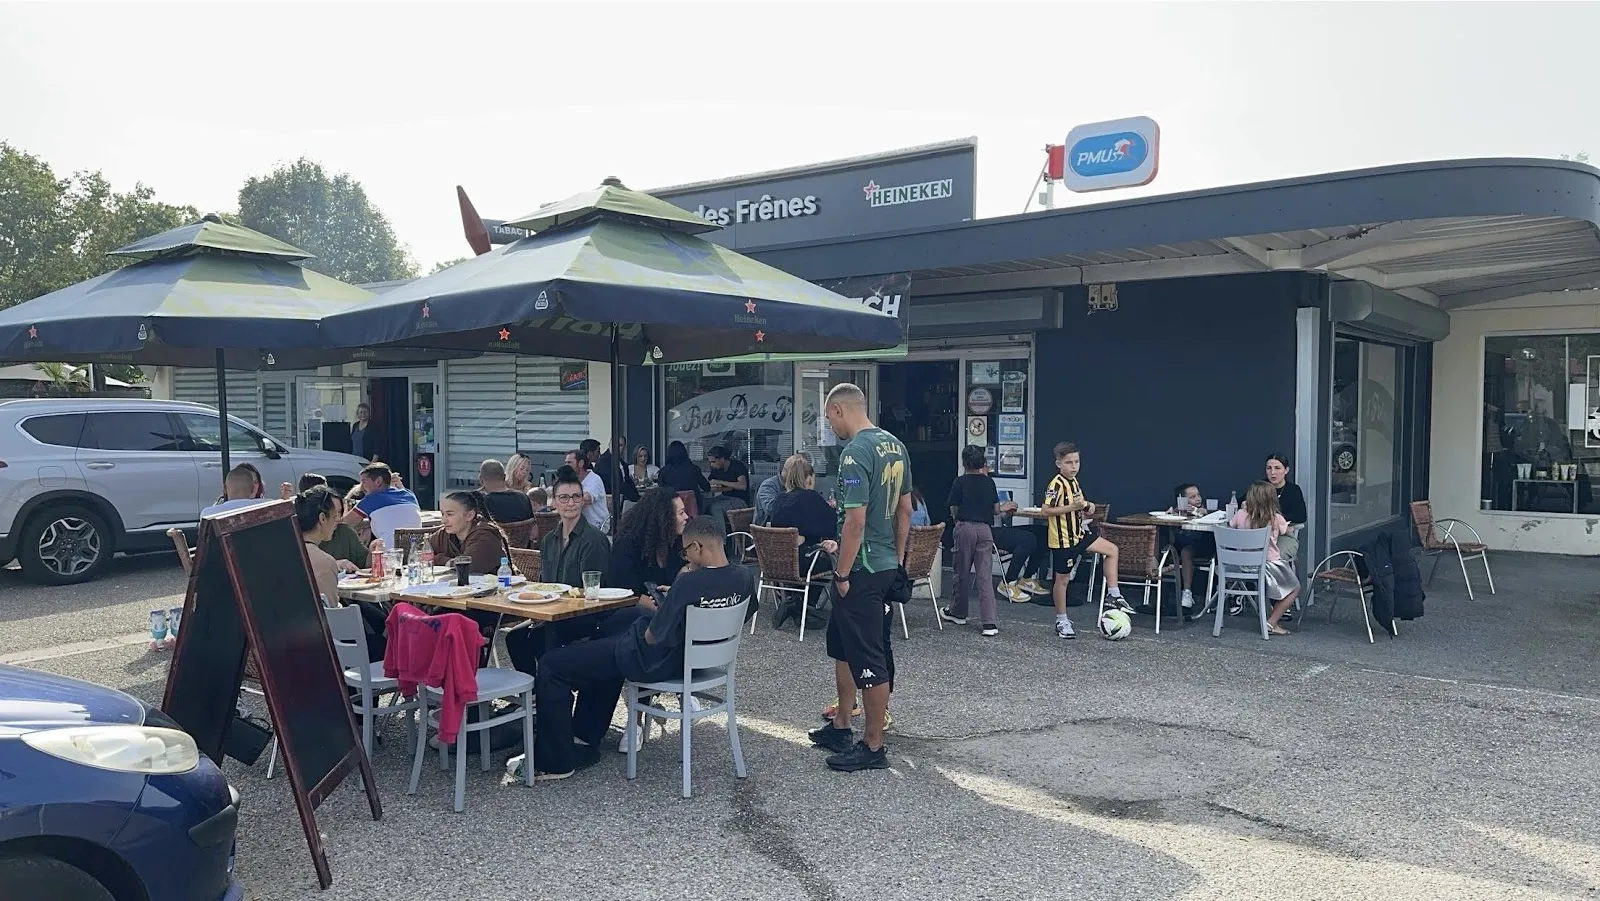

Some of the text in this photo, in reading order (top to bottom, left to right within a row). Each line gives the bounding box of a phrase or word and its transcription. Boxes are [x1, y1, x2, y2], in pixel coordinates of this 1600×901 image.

[1077, 148, 1113, 166] PMU
[872, 180, 952, 206] HEINEKEN
[736, 194, 817, 223] Frênes
[493, 225, 523, 236] TABAC
[682, 403, 722, 433] Bar
[726, 393, 769, 421] Des
